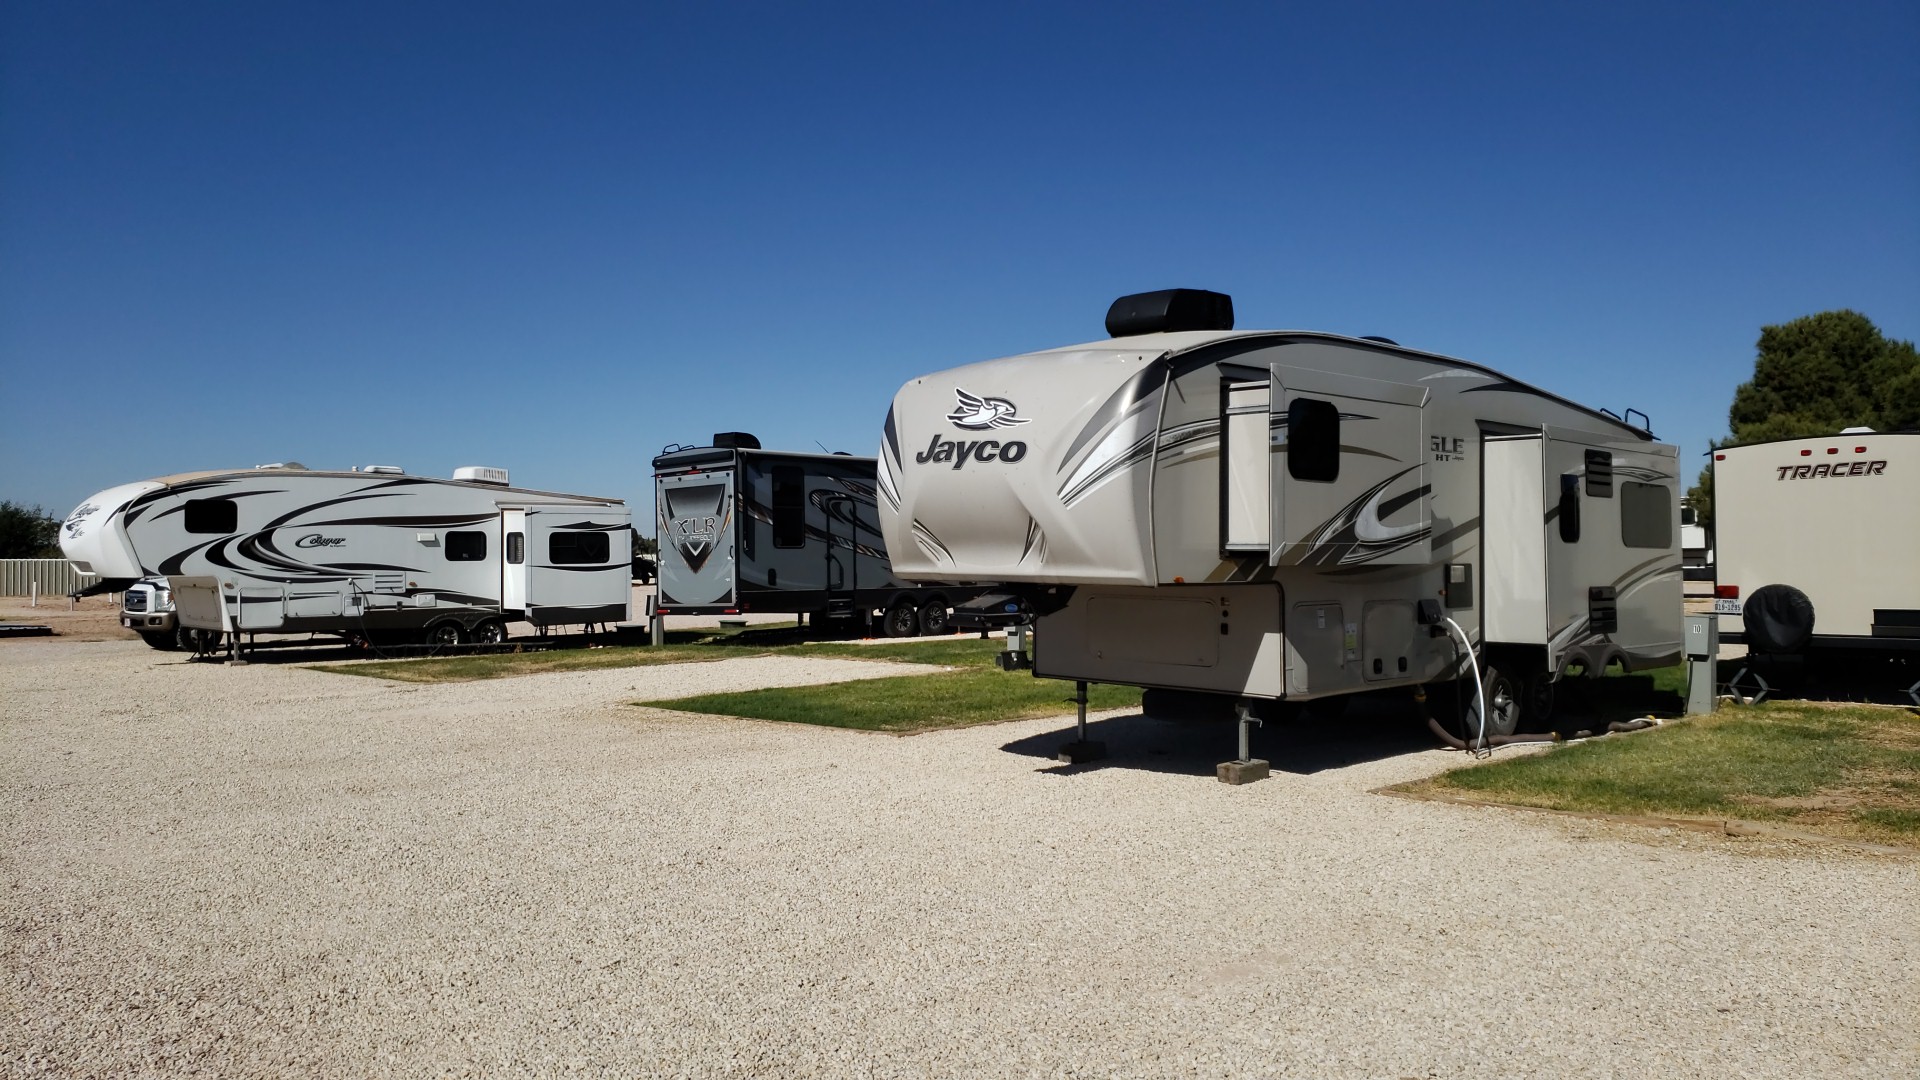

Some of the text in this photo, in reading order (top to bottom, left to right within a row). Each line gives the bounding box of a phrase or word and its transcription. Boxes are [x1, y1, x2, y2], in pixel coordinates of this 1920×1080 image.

[916, 434, 1028, 470] Jayco
[1777, 460, 1887, 480] TRACER
[675, 517, 716, 535] XLR
[295, 533, 346, 548] Cougar
[1694, 625, 1701, 633] 10
